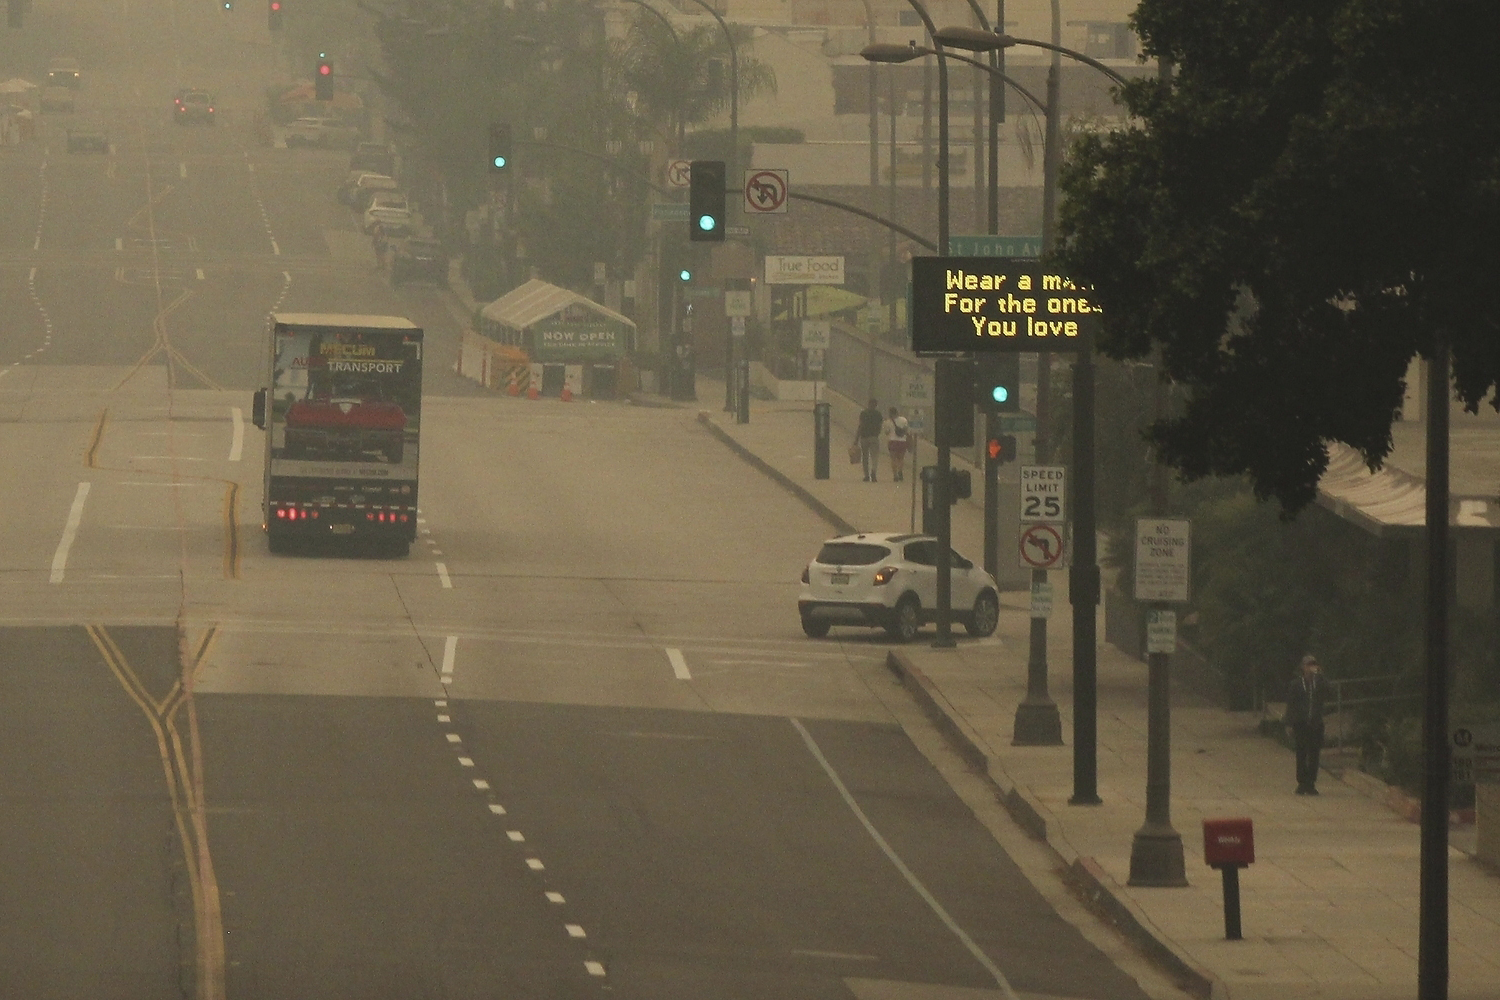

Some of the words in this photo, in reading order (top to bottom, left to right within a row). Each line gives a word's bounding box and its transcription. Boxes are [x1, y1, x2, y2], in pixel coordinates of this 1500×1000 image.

[972, 242, 1014, 256] John
[777, 258, 803, 272] True
[807, 258, 839, 273] Food
[946, 270, 1006, 290] Wear
[1017, 275, 1032, 290] a
[945, 293, 986, 313] For
[997, 293, 1036, 313] the
[972, 316, 1016, 336] You
[1027, 316, 1078, 336] love
[543, 332, 575, 341] NOW
[579, 332, 615, 342] OPEN
[327, 361, 403, 373] TRANSPORT
[1023, 470, 1063, 480] SPEED
[1026, 484, 1059, 492] LIMIT
[1025, 496, 1060, 517] 25
[1156, 526, 1171, 535] NO
[1141, 537, 1185, 547] CRUISING
[1150, 548, 1174, 557] ZONE
